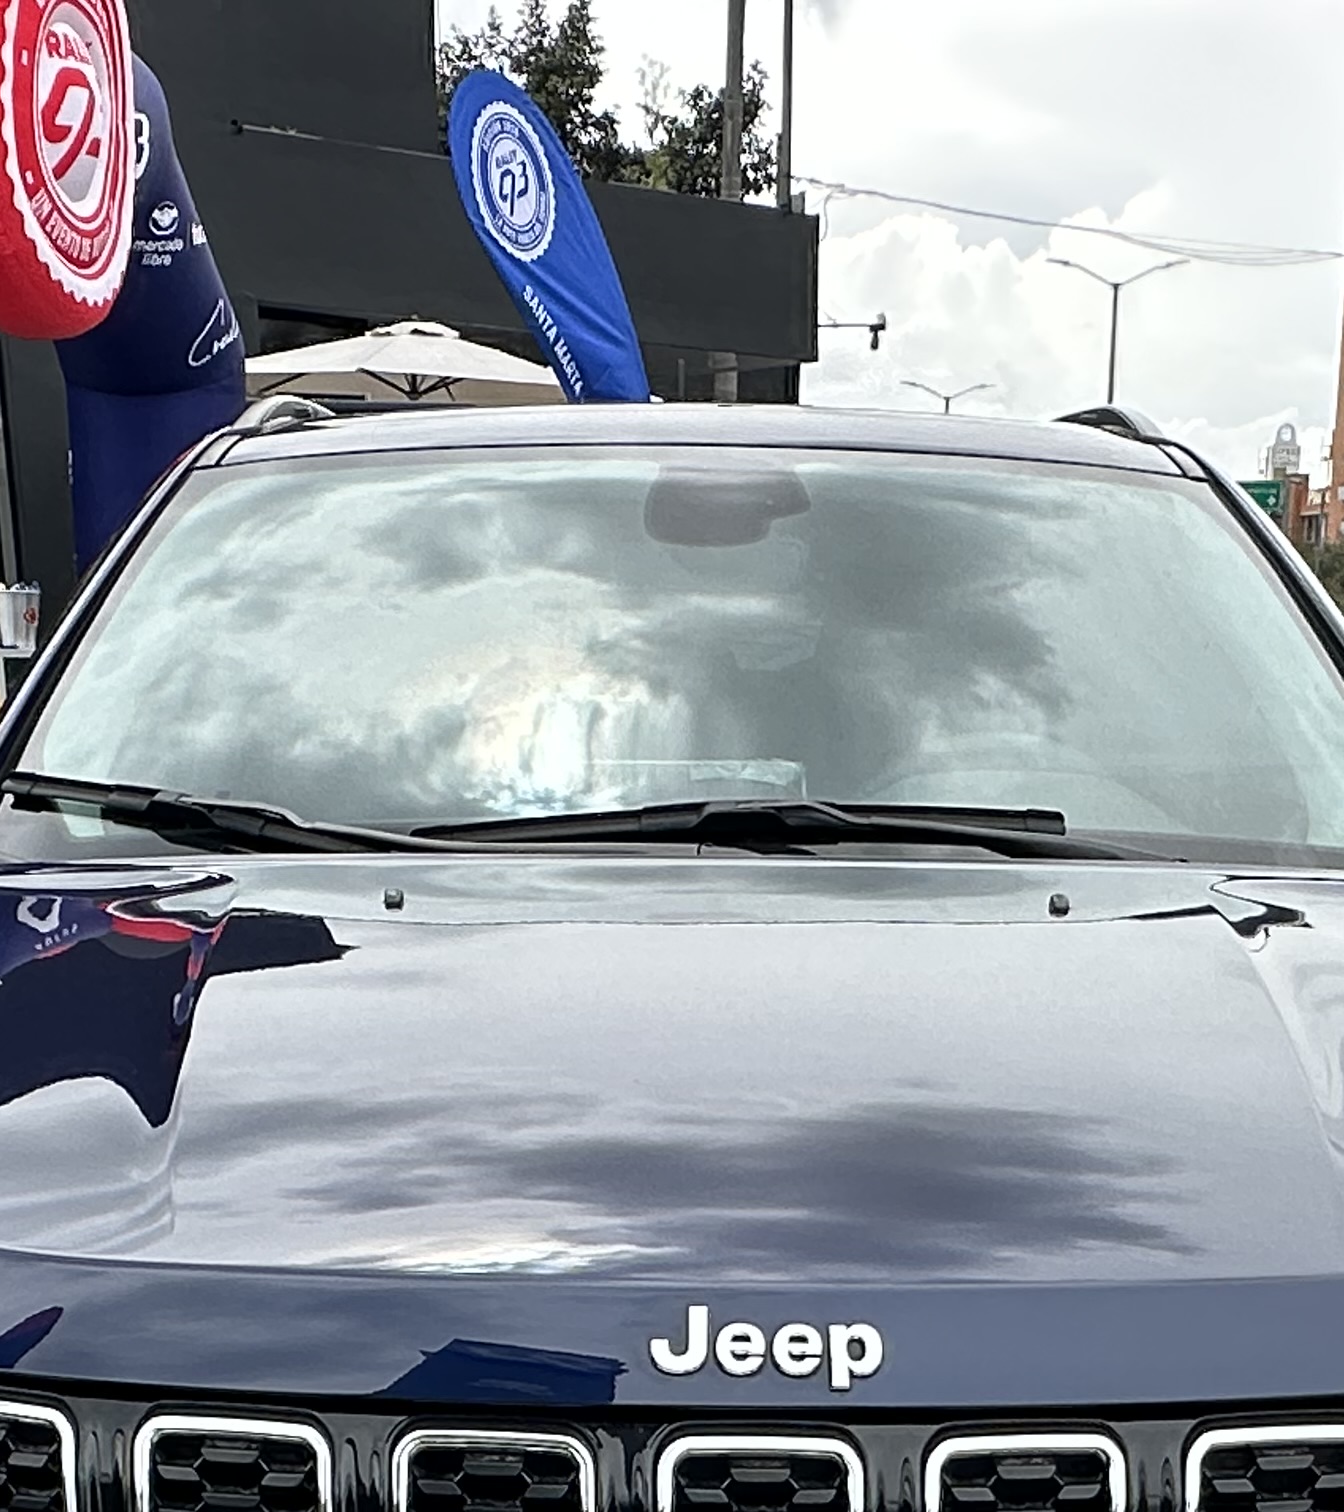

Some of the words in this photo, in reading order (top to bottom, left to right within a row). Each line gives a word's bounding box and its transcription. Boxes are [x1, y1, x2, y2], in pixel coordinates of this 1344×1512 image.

[523, 284, 558, 345] SANTA
[554, 336, 583, 397] MARTA
[649, 1304, 885, 1392] Jeep
